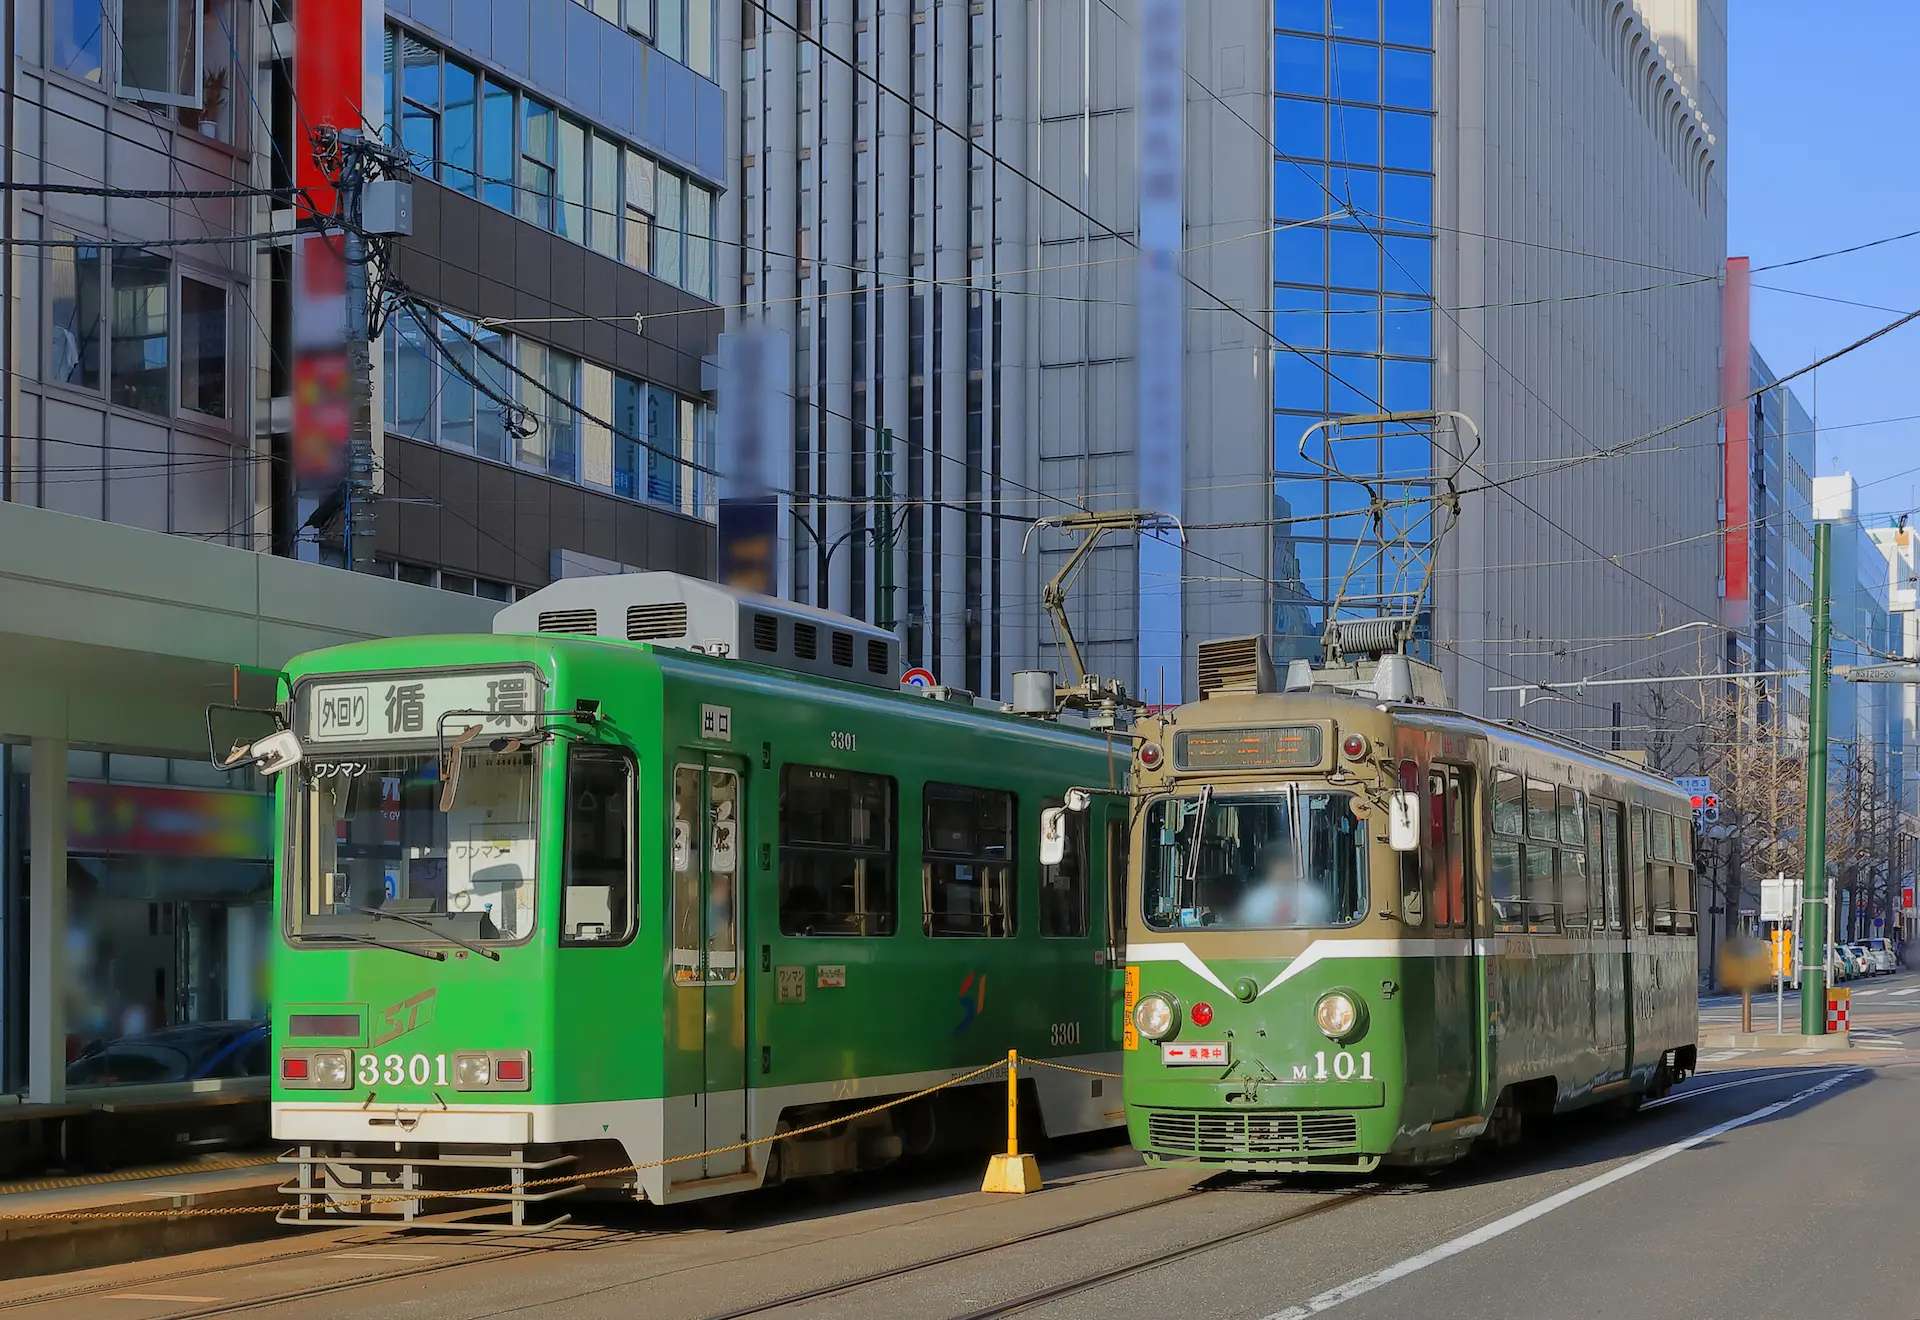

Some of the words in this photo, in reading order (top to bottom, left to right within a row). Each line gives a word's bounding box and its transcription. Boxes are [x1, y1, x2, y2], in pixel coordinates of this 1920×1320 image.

[322, 696, 366, 729] 外回り
[705, 711, 728, 733] 出口
[830, 731, 856, 751] 3301
[314, 763, 367, 778] ワンマン
[1051, 1022, 1080, 1046] 3301
[358, 1053, 449, 1086] 3301
